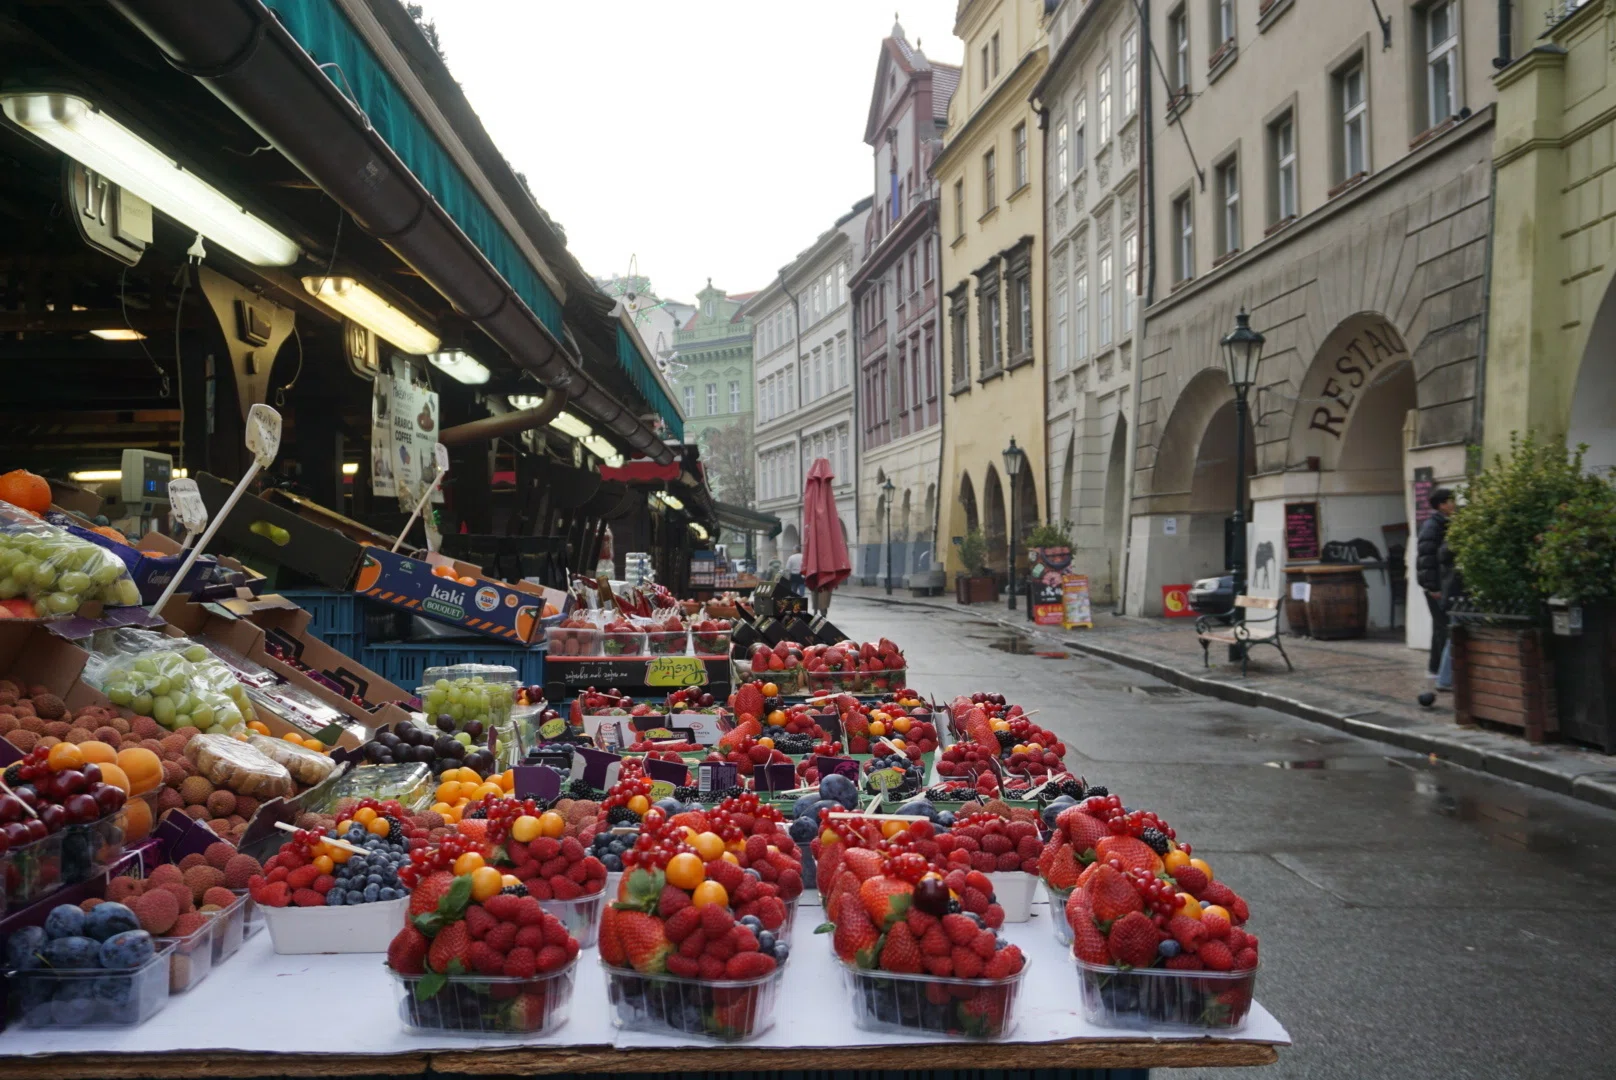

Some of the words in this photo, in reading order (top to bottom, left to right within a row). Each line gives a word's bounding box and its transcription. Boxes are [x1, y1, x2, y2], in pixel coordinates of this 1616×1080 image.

[83, 168, 108, 226] 17
[1308, 321, 1407, 439] RESTAU
[394, 416, 414, 430] ARABICA
[395, 430, 412, 444] COFFEE
[430, 584, 466, 606] kaki
[426, 601, 462, 618] BOUQUET
[645, 658, 708, 685] Prestige
